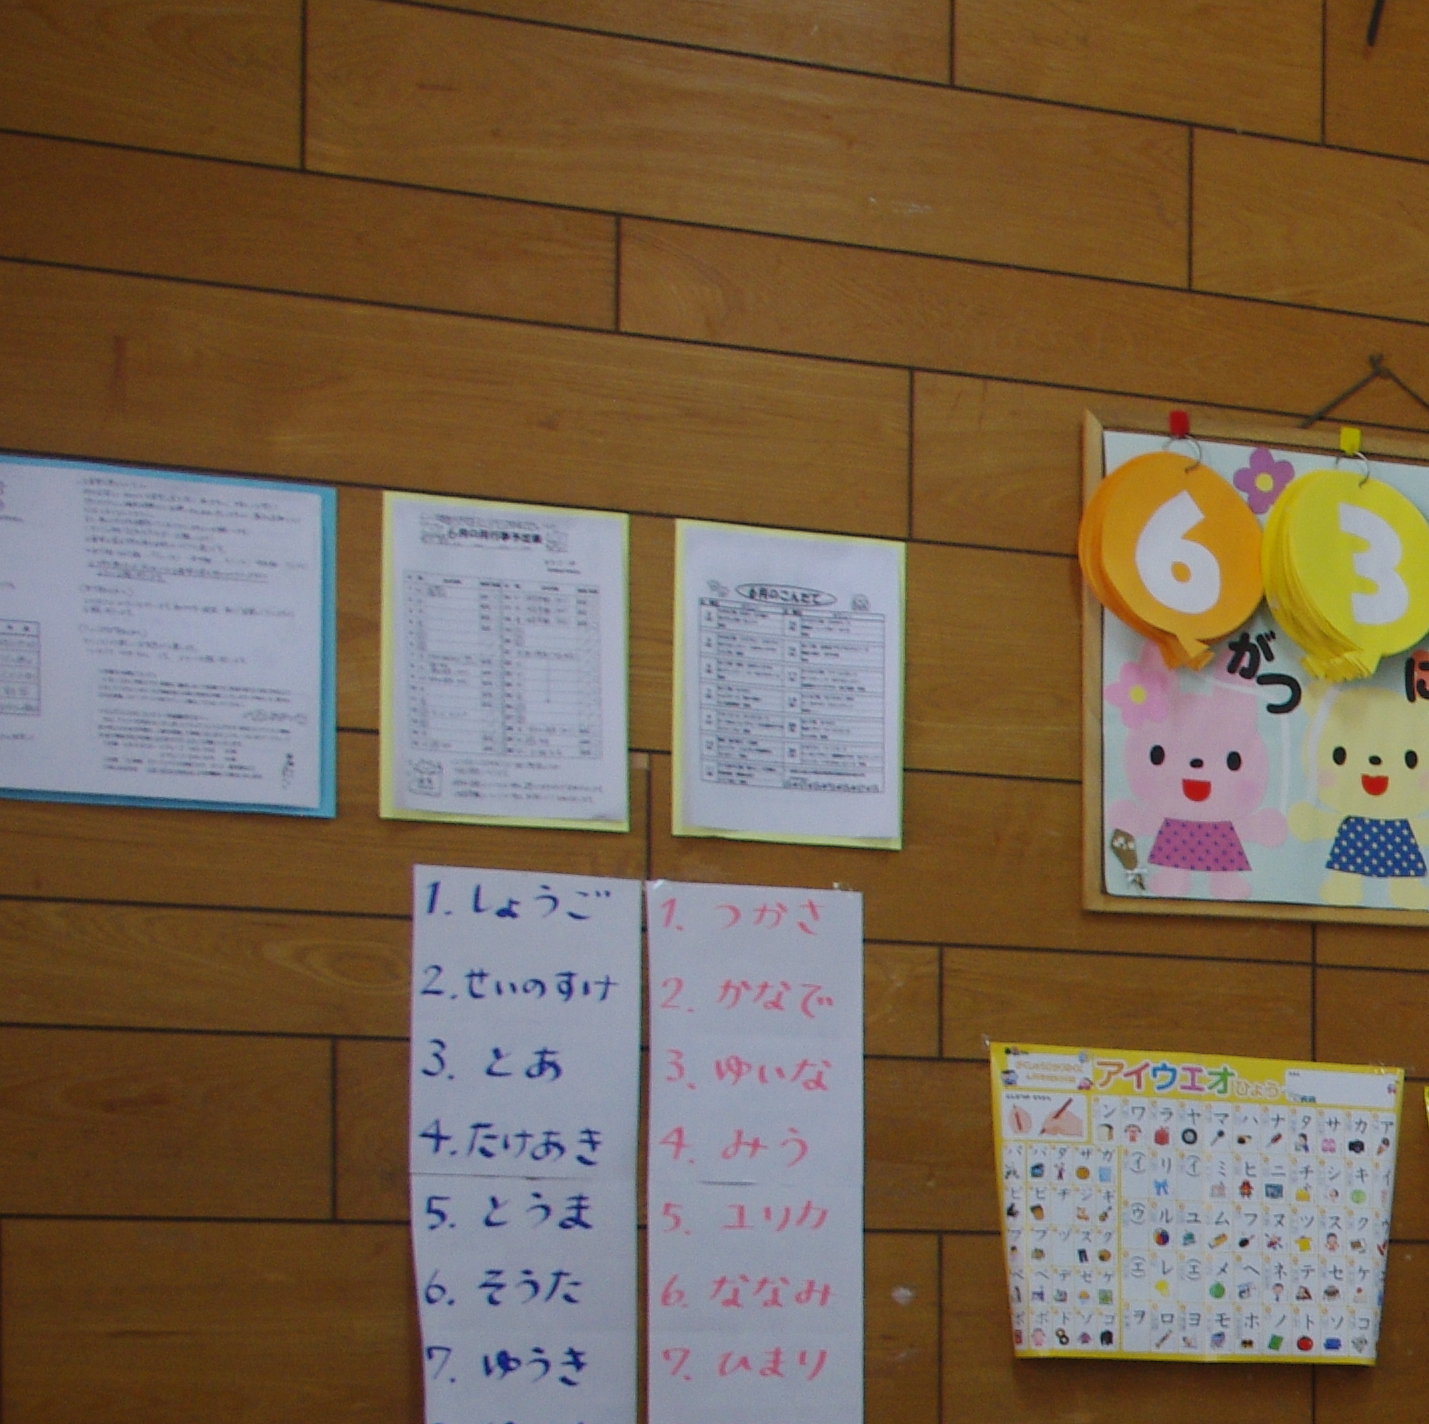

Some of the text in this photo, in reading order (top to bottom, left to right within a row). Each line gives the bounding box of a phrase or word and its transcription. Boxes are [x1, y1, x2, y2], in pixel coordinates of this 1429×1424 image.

[1136, 490, 1221, 614] 6
[1228, 630, 1302, 714] がつ
[1338, 502, 1410, 627] 3
